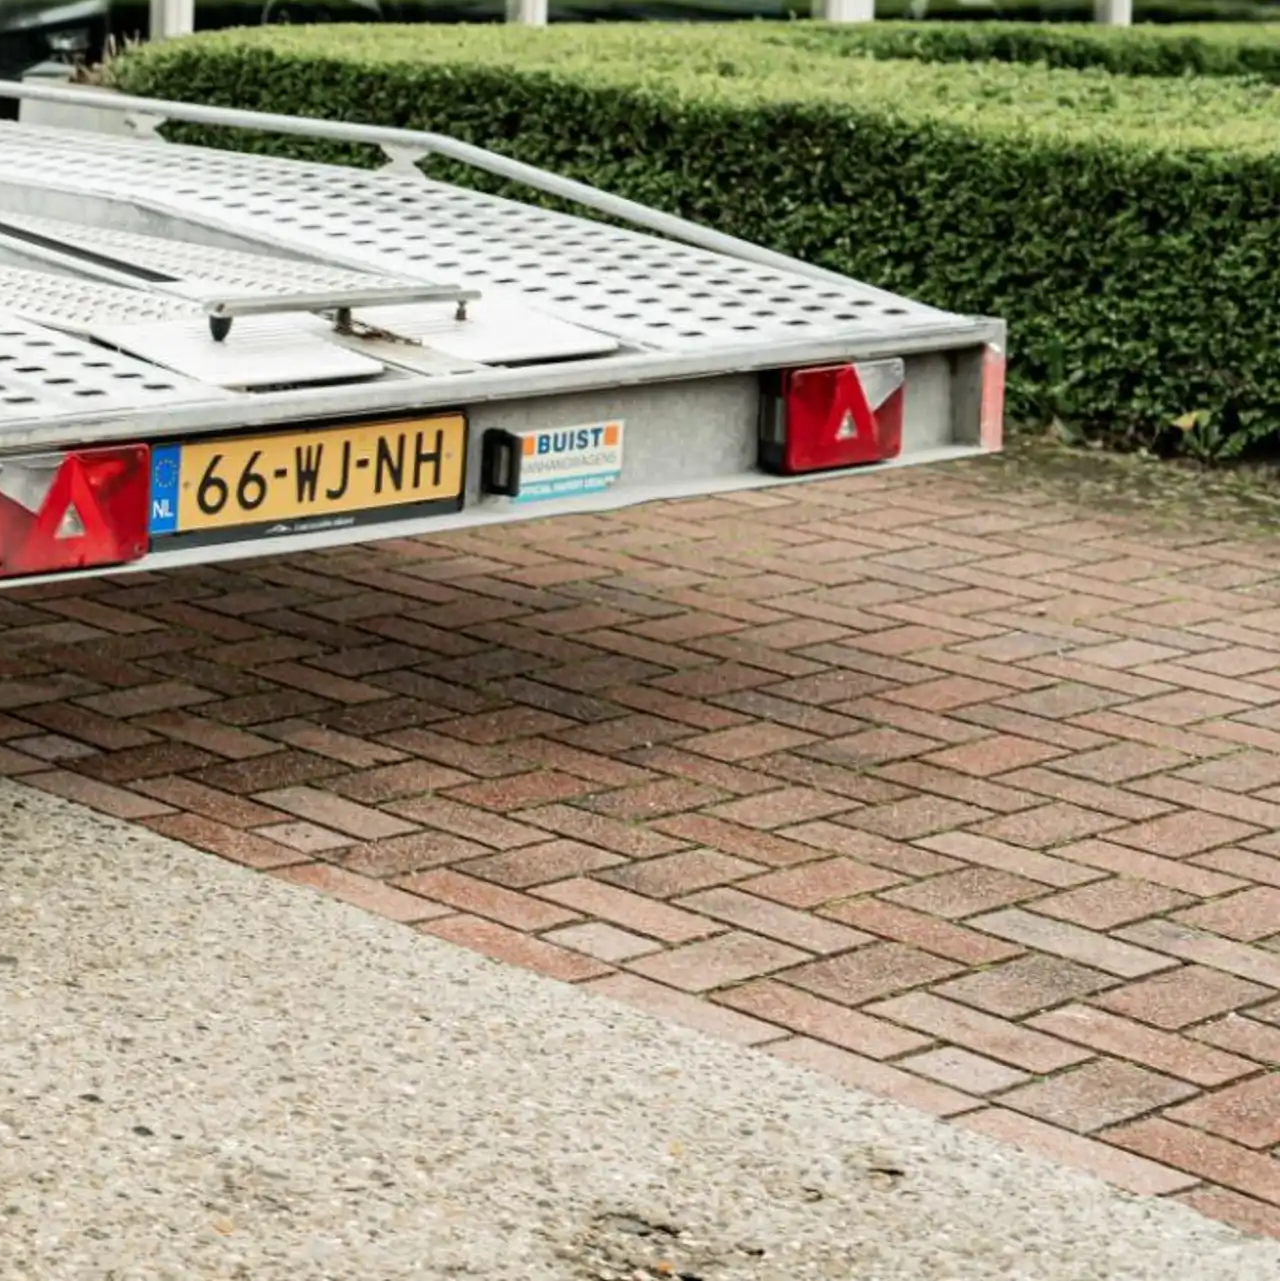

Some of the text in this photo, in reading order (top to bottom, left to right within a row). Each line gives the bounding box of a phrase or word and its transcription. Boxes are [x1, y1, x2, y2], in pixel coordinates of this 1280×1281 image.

[537, 426, 604, 455] BUIST
[197, 429, 444, 515] 66-WJ-NH
[152, 498, 175, 519] NL
